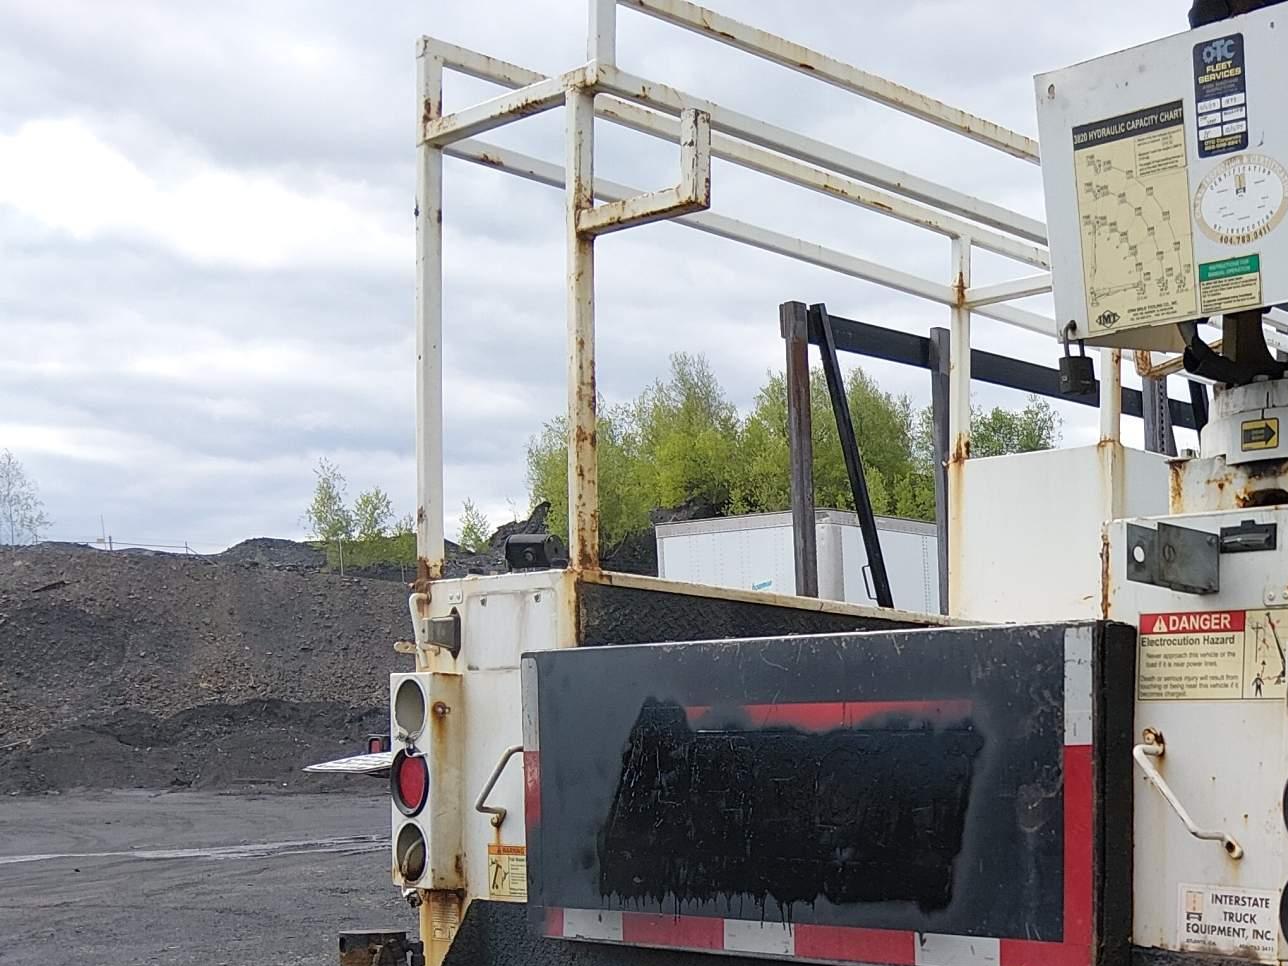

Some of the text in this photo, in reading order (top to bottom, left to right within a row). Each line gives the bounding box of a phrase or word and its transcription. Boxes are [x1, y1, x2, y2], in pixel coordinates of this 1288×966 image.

[1202, 39, 1235, 63] OTC
[1198, 67, 1241, 84] SERVICES
[1206, 61, 1233, 74] FLEET
[1088, 123, 1125, 141] HYDRAULIC
[1126, 114, 1159, 130] CAPACITY
[1159, 108, 1183, 122] CHART
[1169, 614, 1231, 631] DANGER
[1141, 635, 1235, 647] Electrocution Hazard
[1211, 894, 1270, 909] INTERSTATE
[1223, 911, 1257, 924] TRUCK
[1186, 922, 1275, 941] EQUIPMENT, INC.
